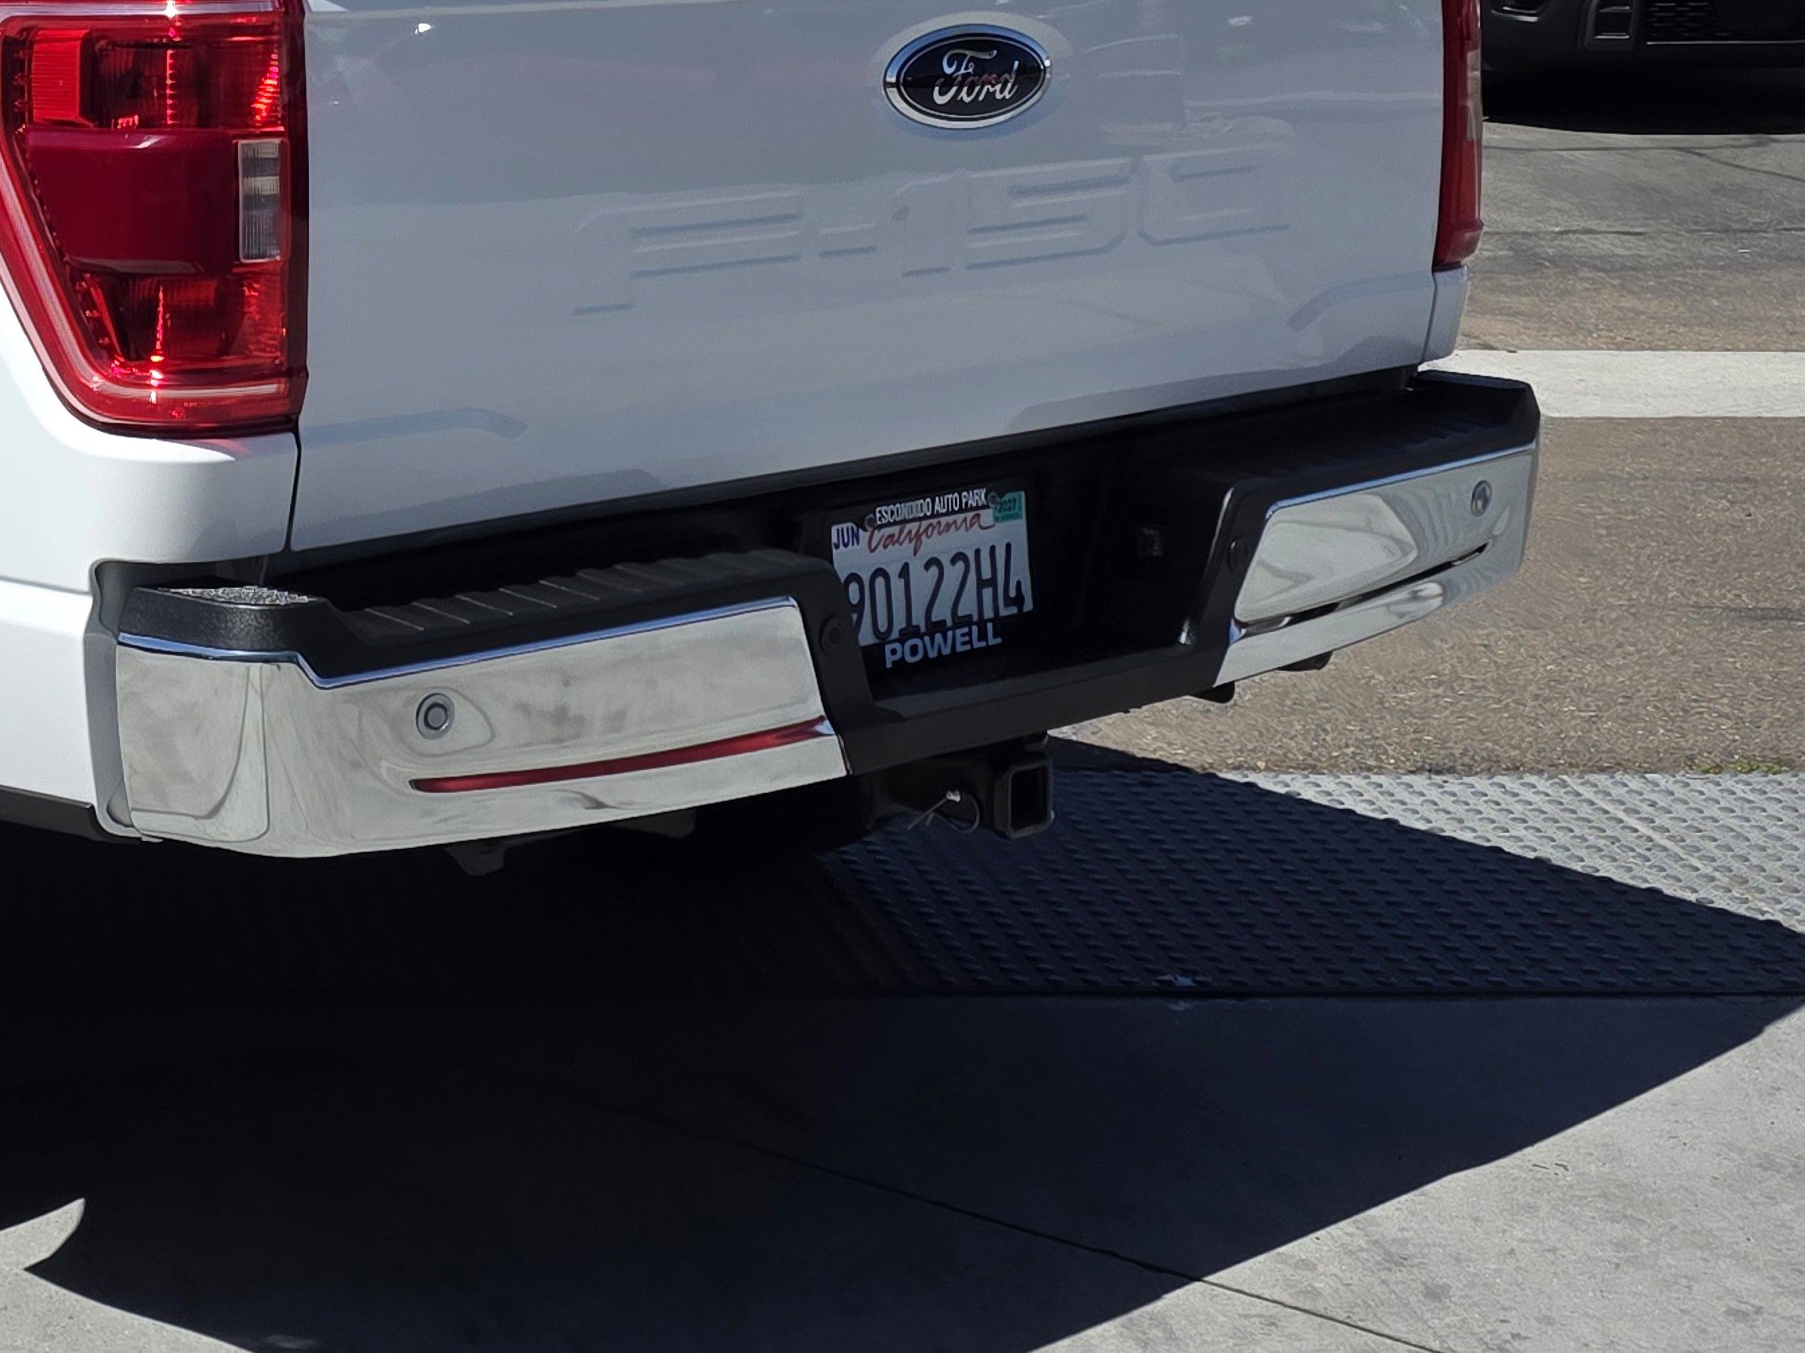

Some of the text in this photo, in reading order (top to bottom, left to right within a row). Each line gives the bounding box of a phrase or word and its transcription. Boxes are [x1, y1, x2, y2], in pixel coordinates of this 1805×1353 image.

[932, 49, 1020, 106] Ford
[875, 488, 988, 525] ESCONDIDO AUTO PARK
[833, 525, 861, 550] JUN
[867, 512, 996, 557] California
[843, 541, 1026, 641] 90122H4
[884, 622, 1003, 669] POWELL
